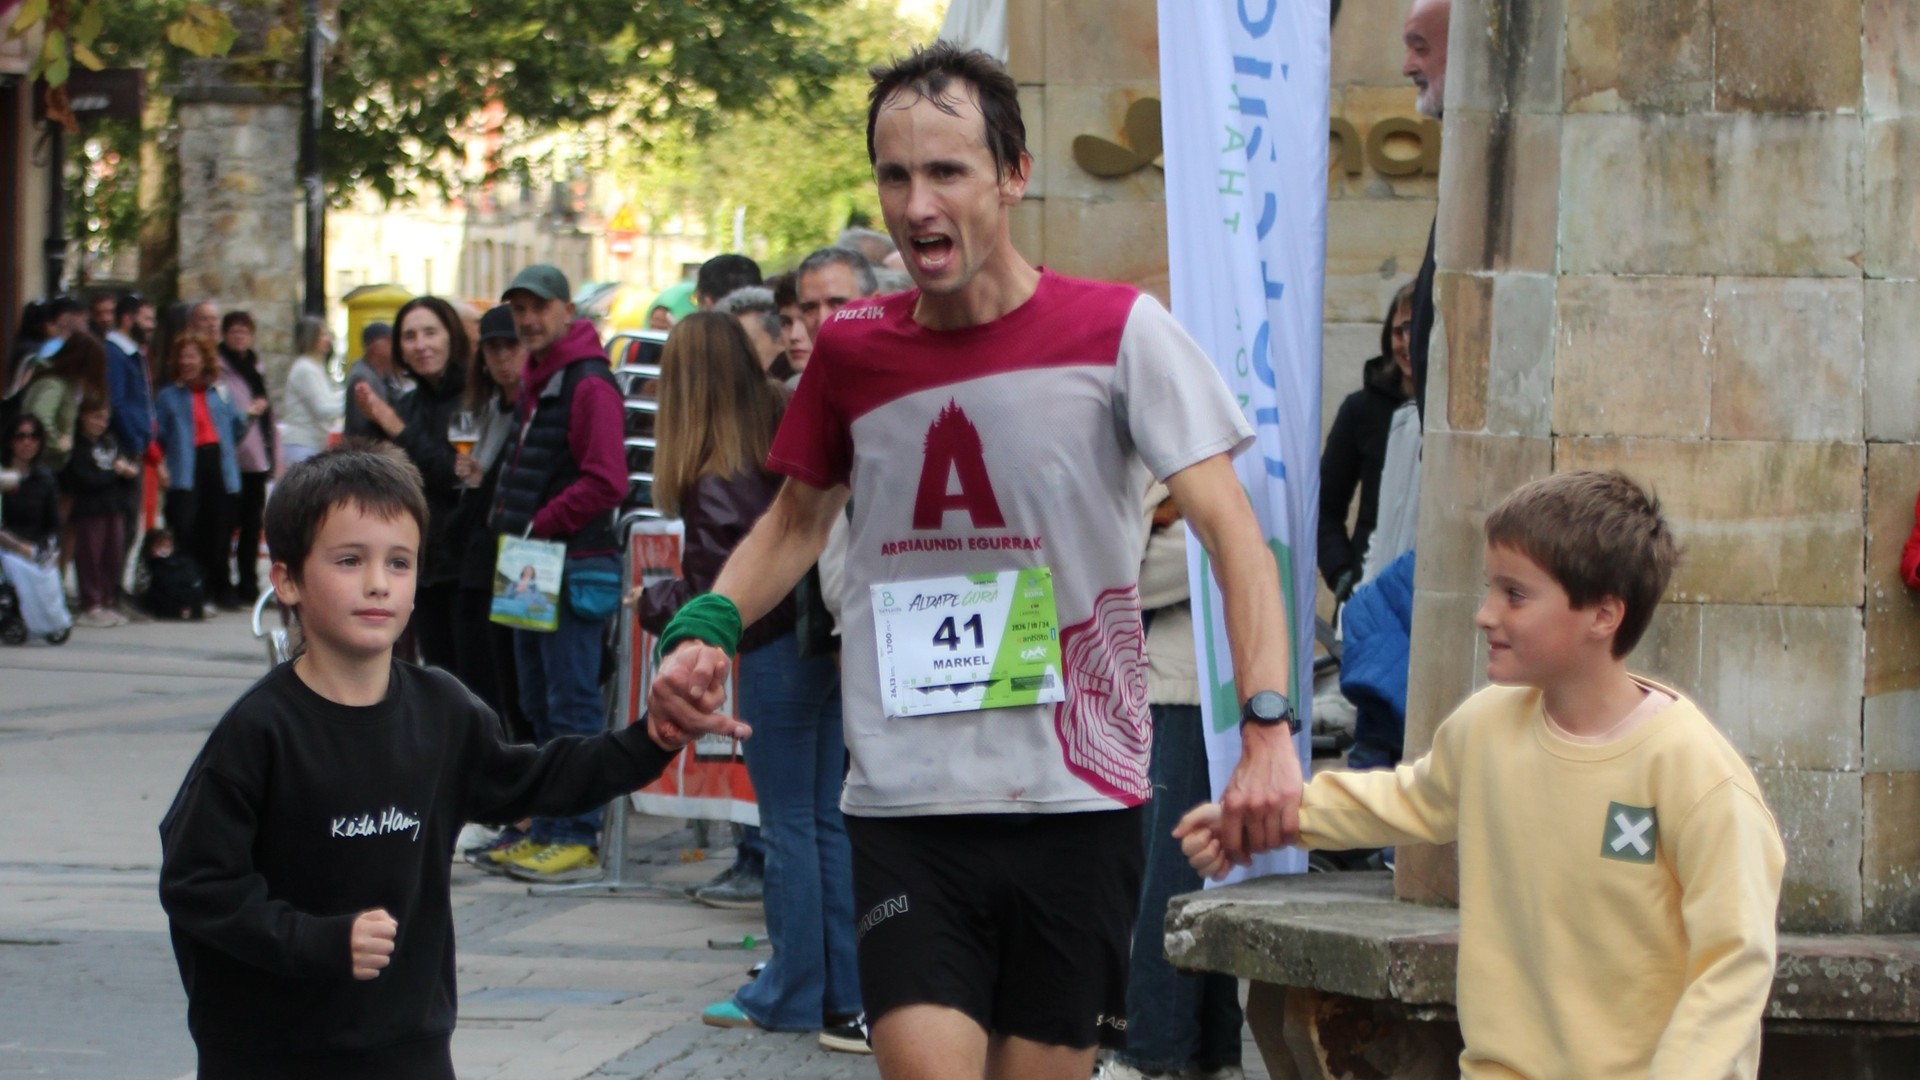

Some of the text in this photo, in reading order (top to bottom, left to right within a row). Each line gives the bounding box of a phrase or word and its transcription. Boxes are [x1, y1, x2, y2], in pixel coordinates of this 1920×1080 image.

[880, 536, 1043, 557] ARRIAUNDI EGURRAK
[932, 613, 985, 651] 41
[933, 655, 990, 670] MARKEL
[331, 814, 377, 838] Keith
